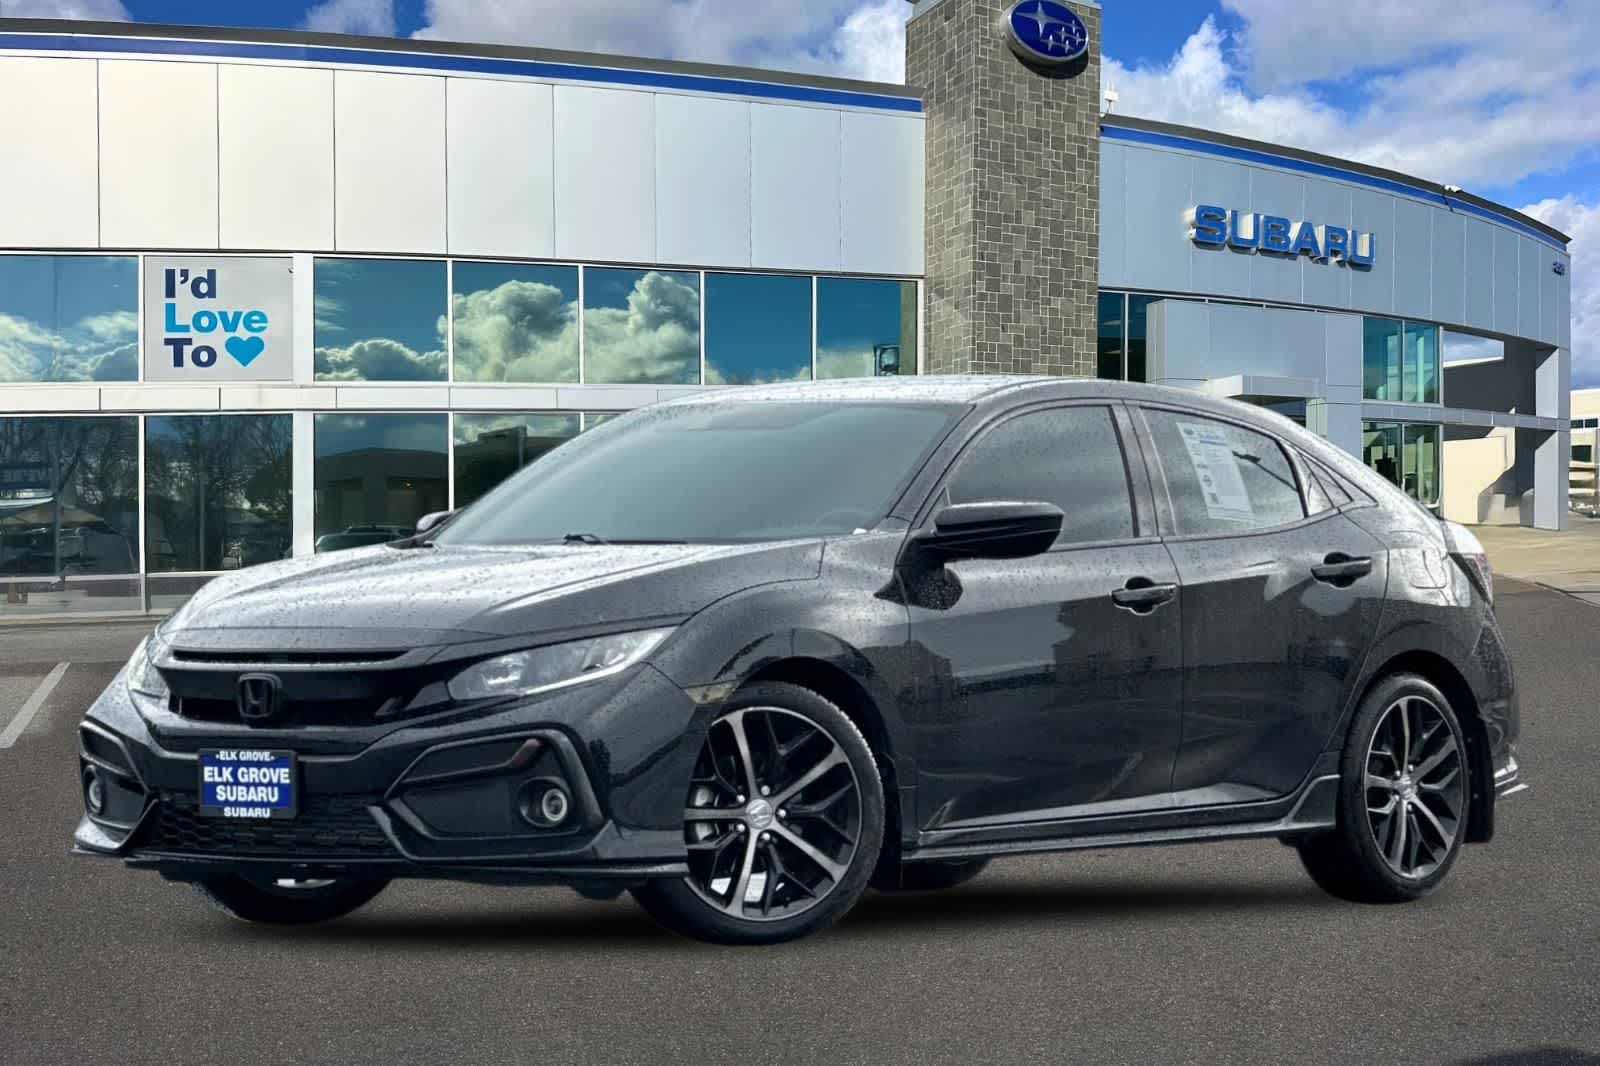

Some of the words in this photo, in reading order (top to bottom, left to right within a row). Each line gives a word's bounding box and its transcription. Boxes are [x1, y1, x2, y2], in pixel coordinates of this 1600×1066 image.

[1190, 204, 1375, 267] SUBARU
[164, 302, 268, 333] Love
[163, 337, 217, 368] To
[203, 766, 234, 782] ELK
[237, 767, 291, 784] GROVE
[215, 785, 279, 803] SUBARU
[223, 806, 271, 818] SUBARU
